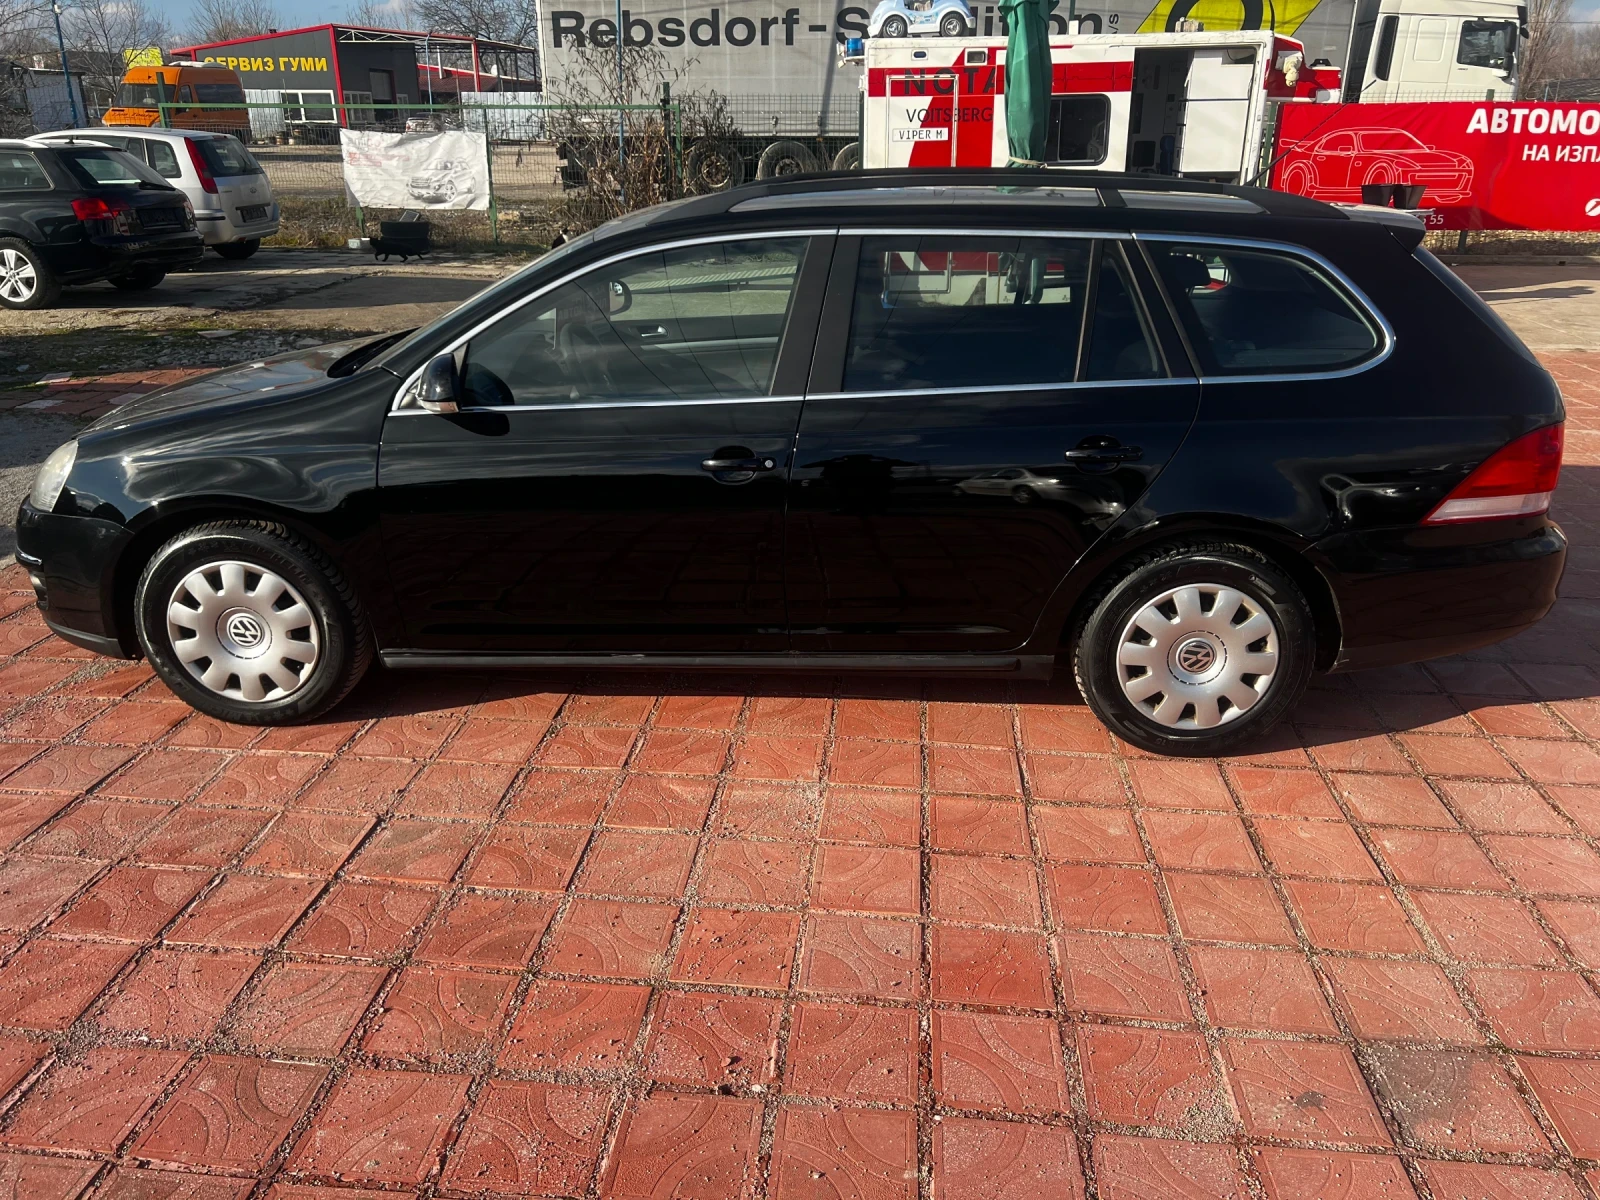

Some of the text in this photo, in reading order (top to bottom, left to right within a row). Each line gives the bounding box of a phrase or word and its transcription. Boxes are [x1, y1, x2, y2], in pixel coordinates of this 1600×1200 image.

[279, 56, 328, 72] ГУМИ
[905, 106, 993, 123] VOITSBERG
[1465, 107, 1600, 136] АВТОМО
[898, 129, 943, 140] VIPER M
[1521, 144, 1600, 163] НА ИЗП
[1428, 213, 1445, 226] 55
